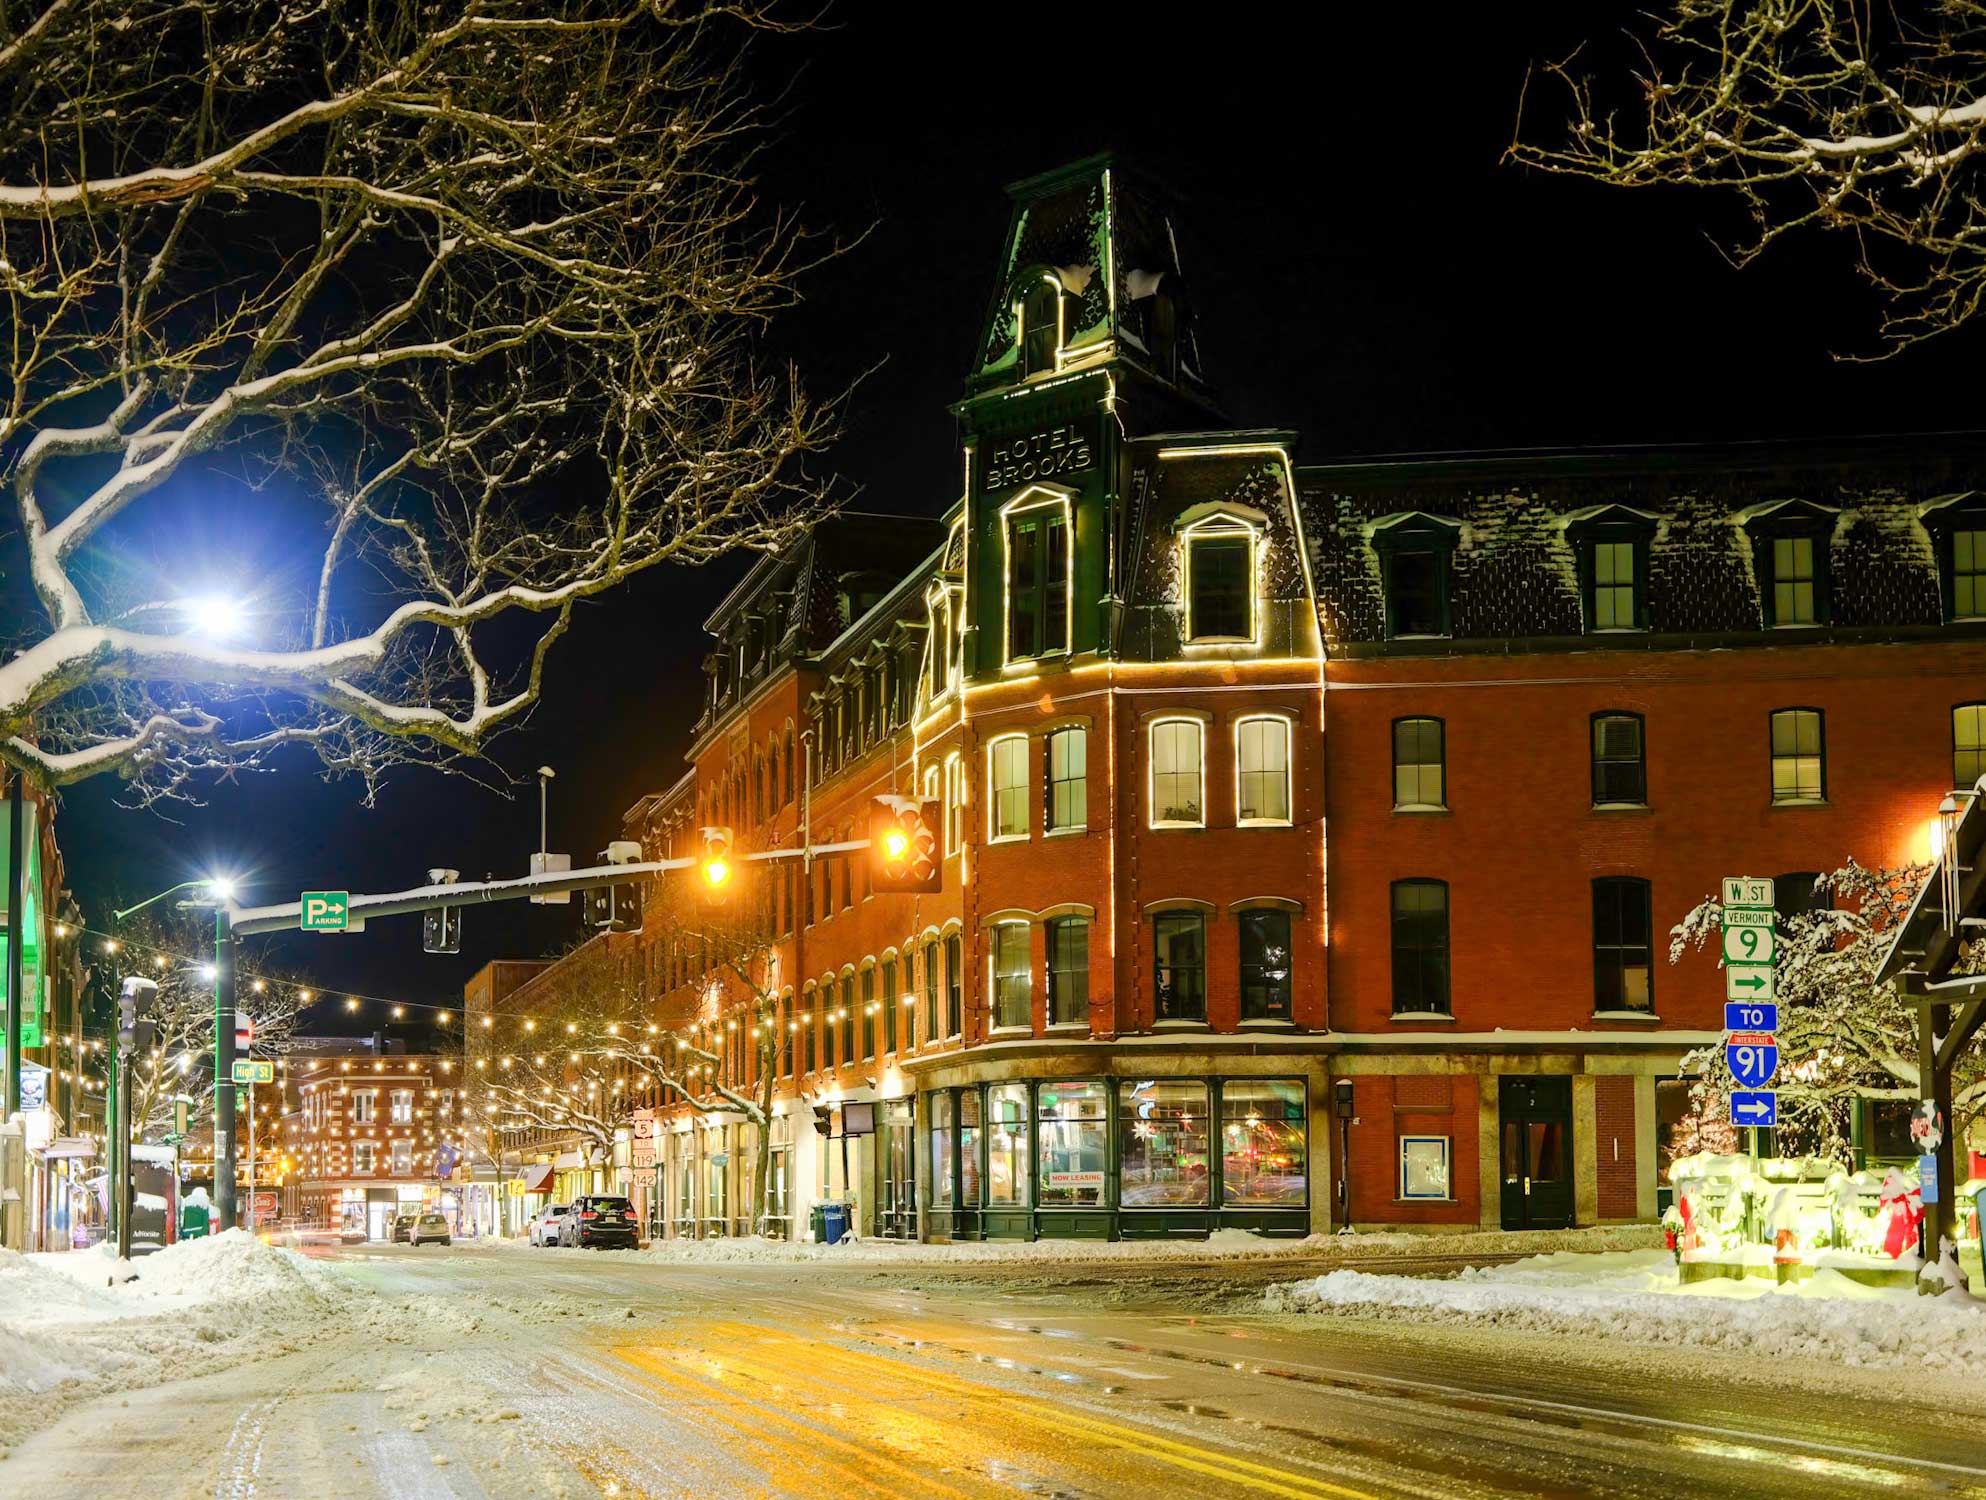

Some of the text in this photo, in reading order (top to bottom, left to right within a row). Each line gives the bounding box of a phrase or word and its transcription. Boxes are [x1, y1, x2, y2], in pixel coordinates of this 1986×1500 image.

[993, 424, 1084, 464] HOTEL
[986, 446, 1091, 489] BROOKS
[1731, 883, 1765, 901] WST
[1728, 912, 1769, 925] VERMONT
[1740, 929, 1758, 959] 9
[1740, 1009, 1764, 1026] TO
[1734, 1036, 1769, 1045] INTERSTATE
[1736, 1046, 1765, 1078] 91
[236, 1064, 255, 1079] High
[640, 1123, 648, 1135] 5
[636, 1155, 653, 1166] 119
[636, 1175, 655, 1186] 142
